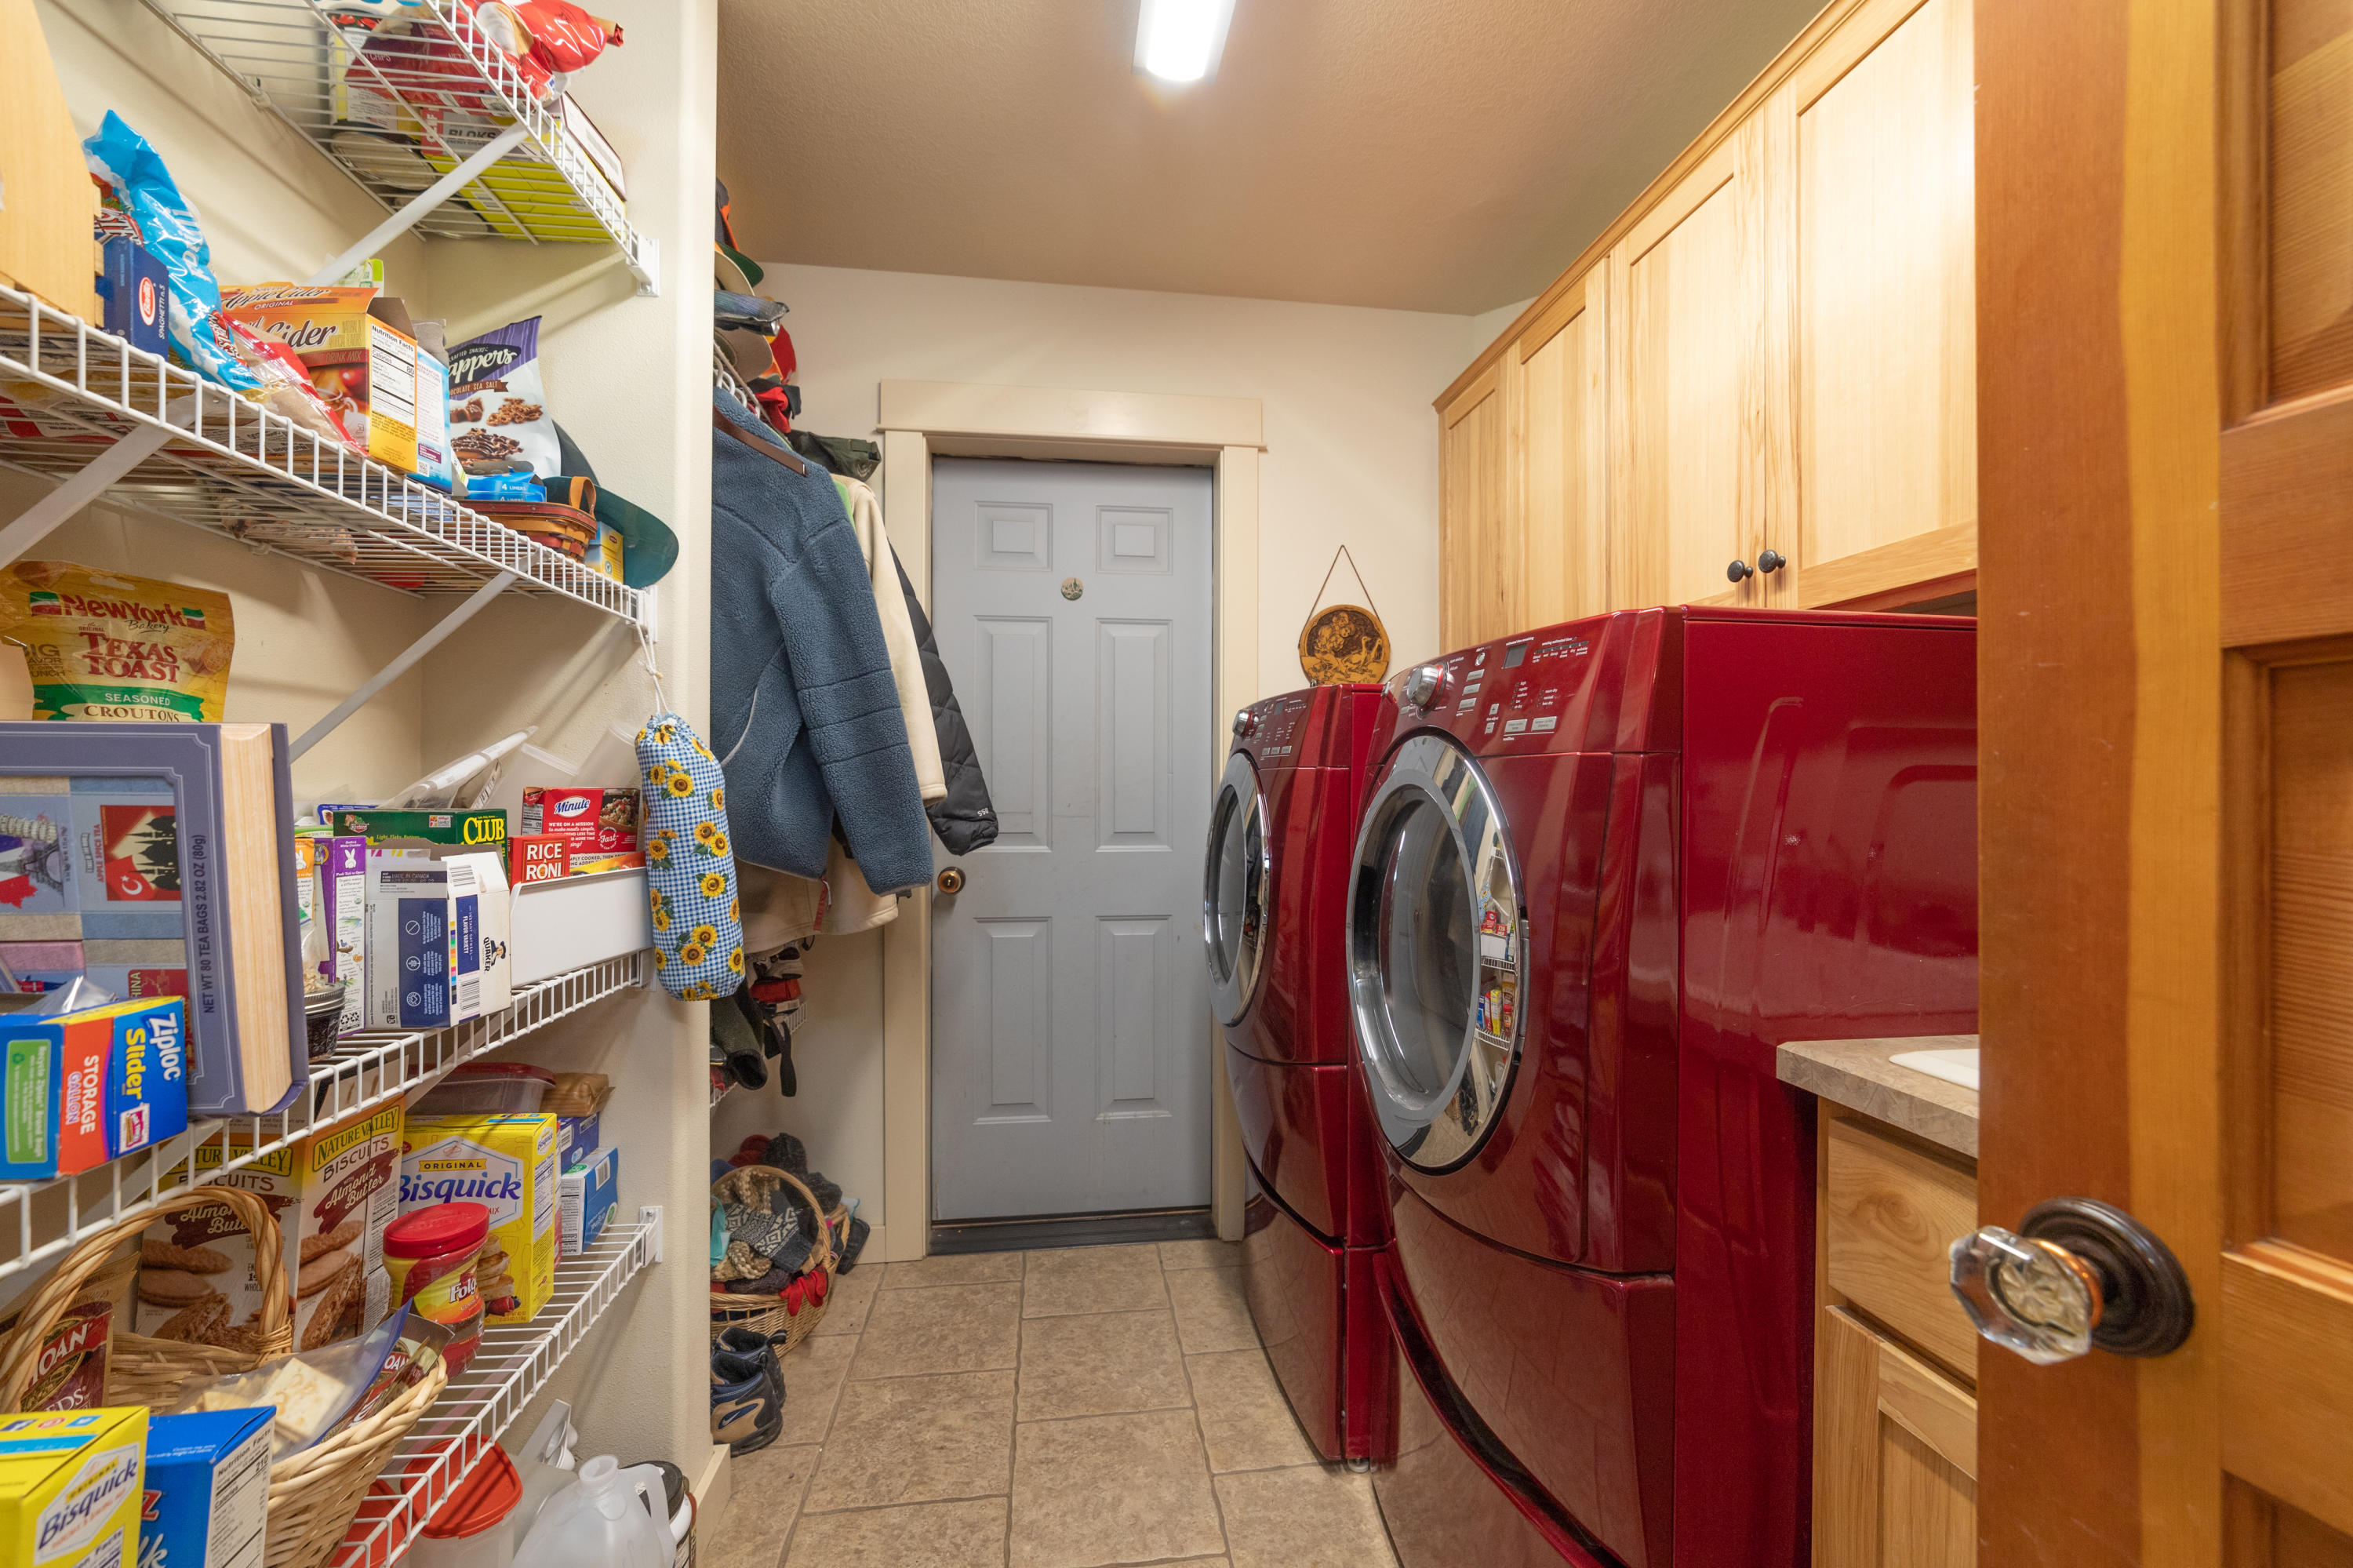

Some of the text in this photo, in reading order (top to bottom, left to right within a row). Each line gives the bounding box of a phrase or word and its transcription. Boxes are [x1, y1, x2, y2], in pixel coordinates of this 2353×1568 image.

[253, 300, 294, 311] ORIGINAL
[372, 325, 398, 344] Nutrition
[398, 340, 414, 352] Facts
[372, 349, 393, 365] Calories
[448, 347, 518, 384] appers
[473, 382, 483, 391] SEA
[486, 380, 498, 390] SALT
[78, 631, 179, 665] TEXAS
[31, 669, 65, 678] UNCH
[82, 654, 180, 683] TOAST
[83, 705, 180, 722] CROUTONS
[104, 692, 170, 707] SEASONED
[553, 795, 591, 815] Minute
[463, 816, 506, 846] CLUB
[93, 824, 104, 883] APPLE SPICE TEA
[526, 842, 562, 860] RICE
[526, 862, 562, 881] RONI
[191, 835, 215, 1013] NET WT 80 TEA BAGS 2.82 OZ (80g)
[129, 972, 142, 999] HINA
[148, 1012, 183, 1082] Ziploc
[125, 1027, 147, 1101] Slider
[65, 1071, 82, 1126] GALLON
[79, 1054, 100, 1136] STORAGE
[318, 1109, 398, 1161] NATURE VALLEY
[323, 1137, 390, 1183] BISCUITS
[423, 1161, 482, 1170] ORIGINAL
[325, 1162, 376, 1210] Almond
[344, 1175, 384, 1210] Butter
[398, 1171, 521, 1204] Bisquick
[180, 1203, 234, 1222] Almo
[449, 1277, 478, 1304] Folg
[218, 1446, 250, 1476] Nutrition
[253, 1428, 271, 1448] Facts
[256, 1454, 269, 1472] 210
[38, 1458, 139, 1551] Bisquick
[215, 1485, 239, 1509] Calories
